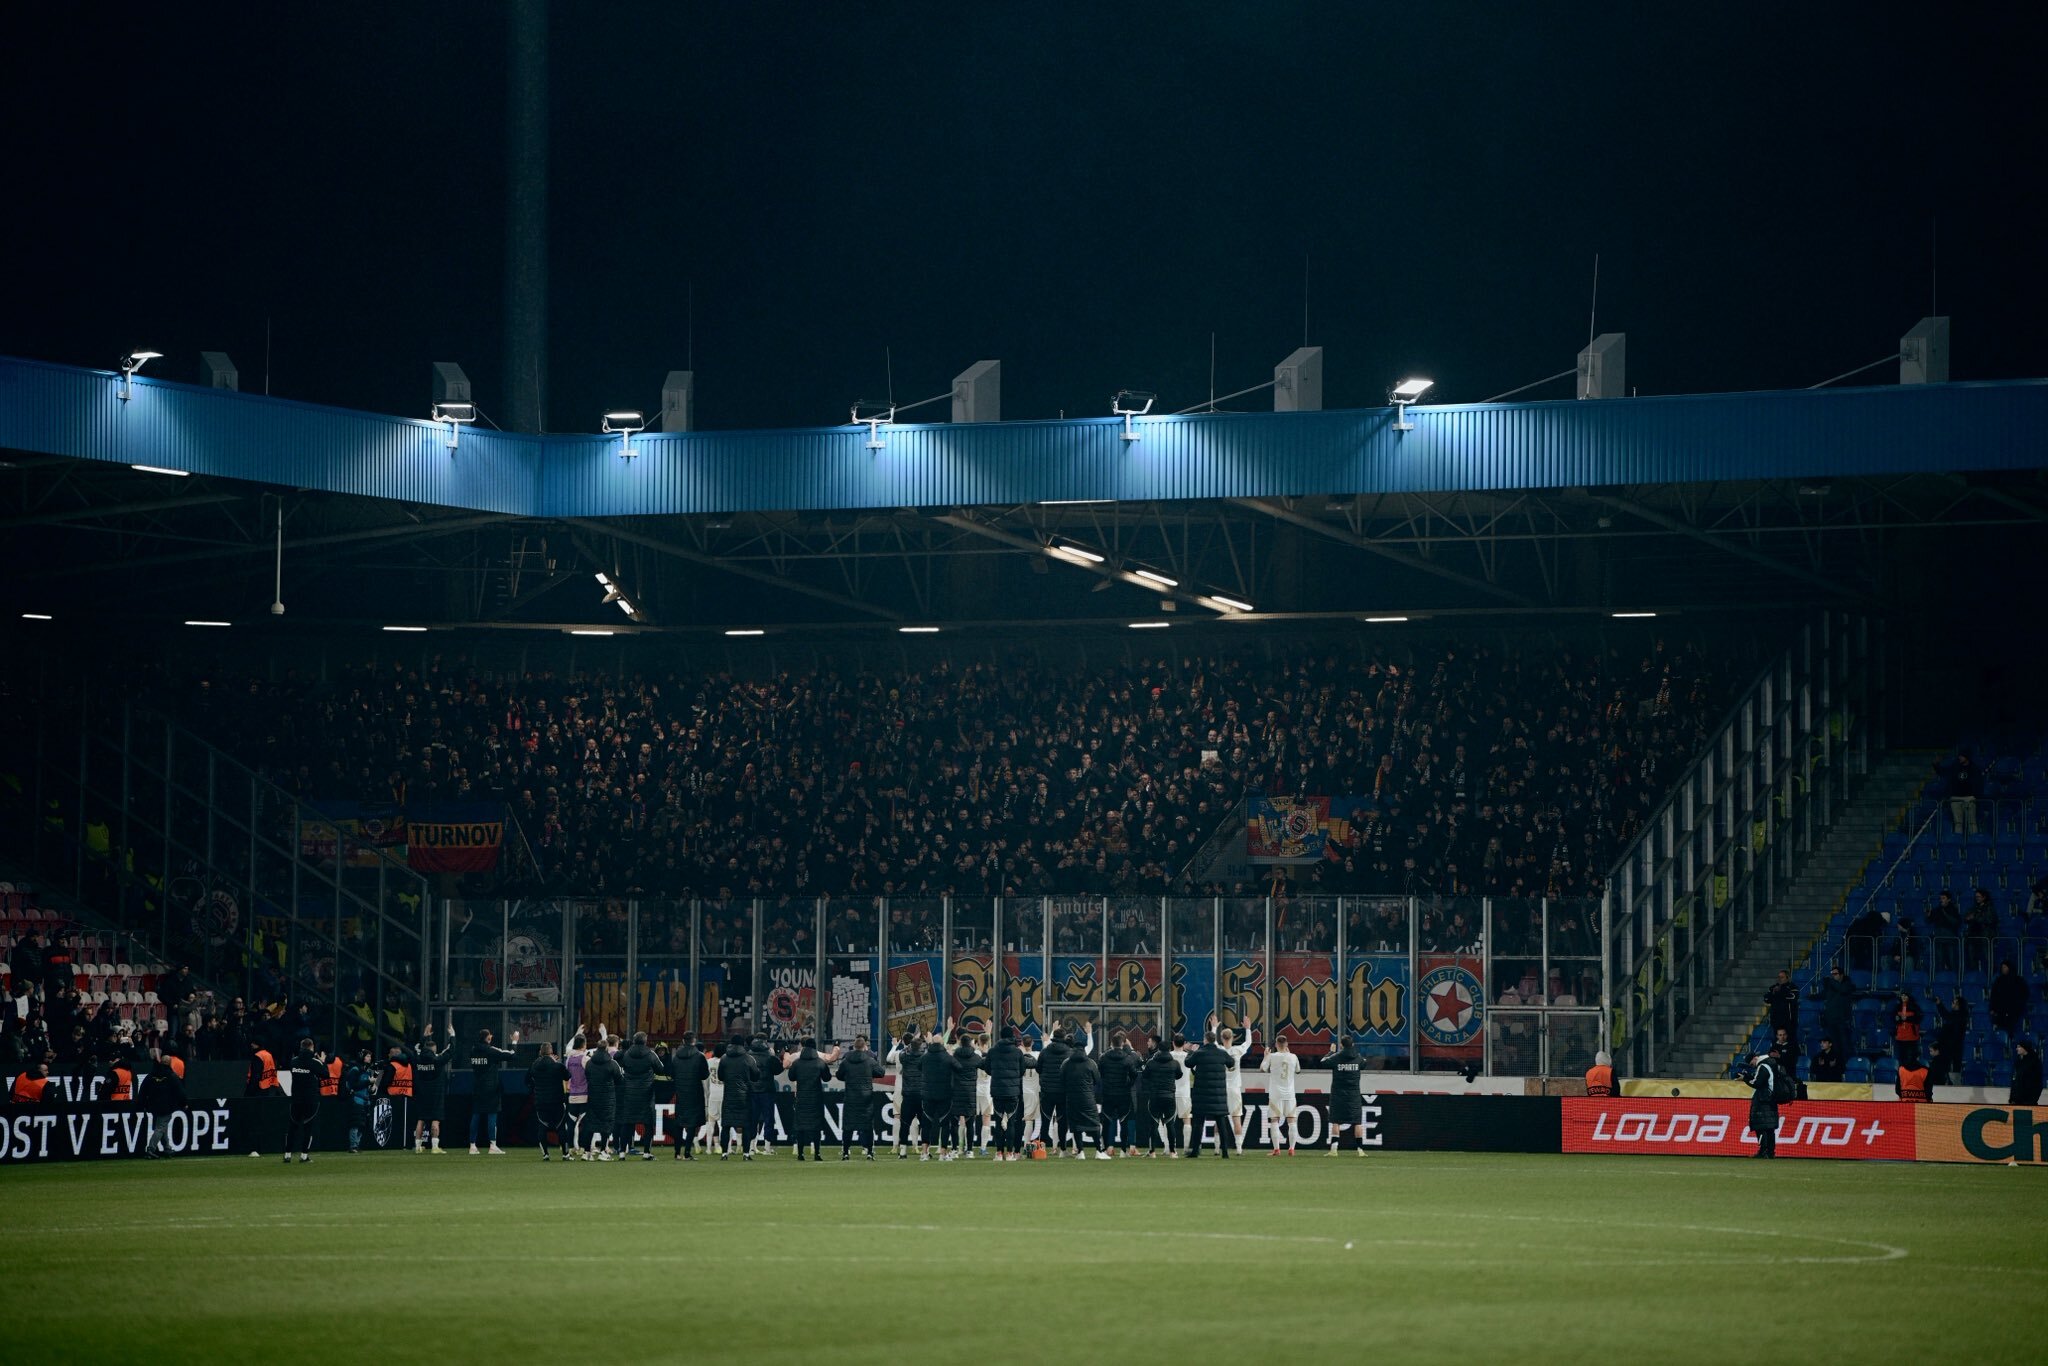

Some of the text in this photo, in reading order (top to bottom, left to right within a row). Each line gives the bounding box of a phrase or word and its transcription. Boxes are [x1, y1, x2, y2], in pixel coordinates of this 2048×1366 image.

[411, 825, 499, 847] TURNOV
[770, 968, 818, 988] YOUN
[1418, 970, 1464, 1003] ATHLETIC
[1204, 960, 1406, 1045] Sparta
[1469, 985, 1482, 1020] CLUB
[1421, 1018, 1470, 1043] SPARTA
[67, 1113, 91, 1156] V
[1200, 1095, 1383, 1147] VROĚ
[1961, 1107, 2048, 1163] Ch
